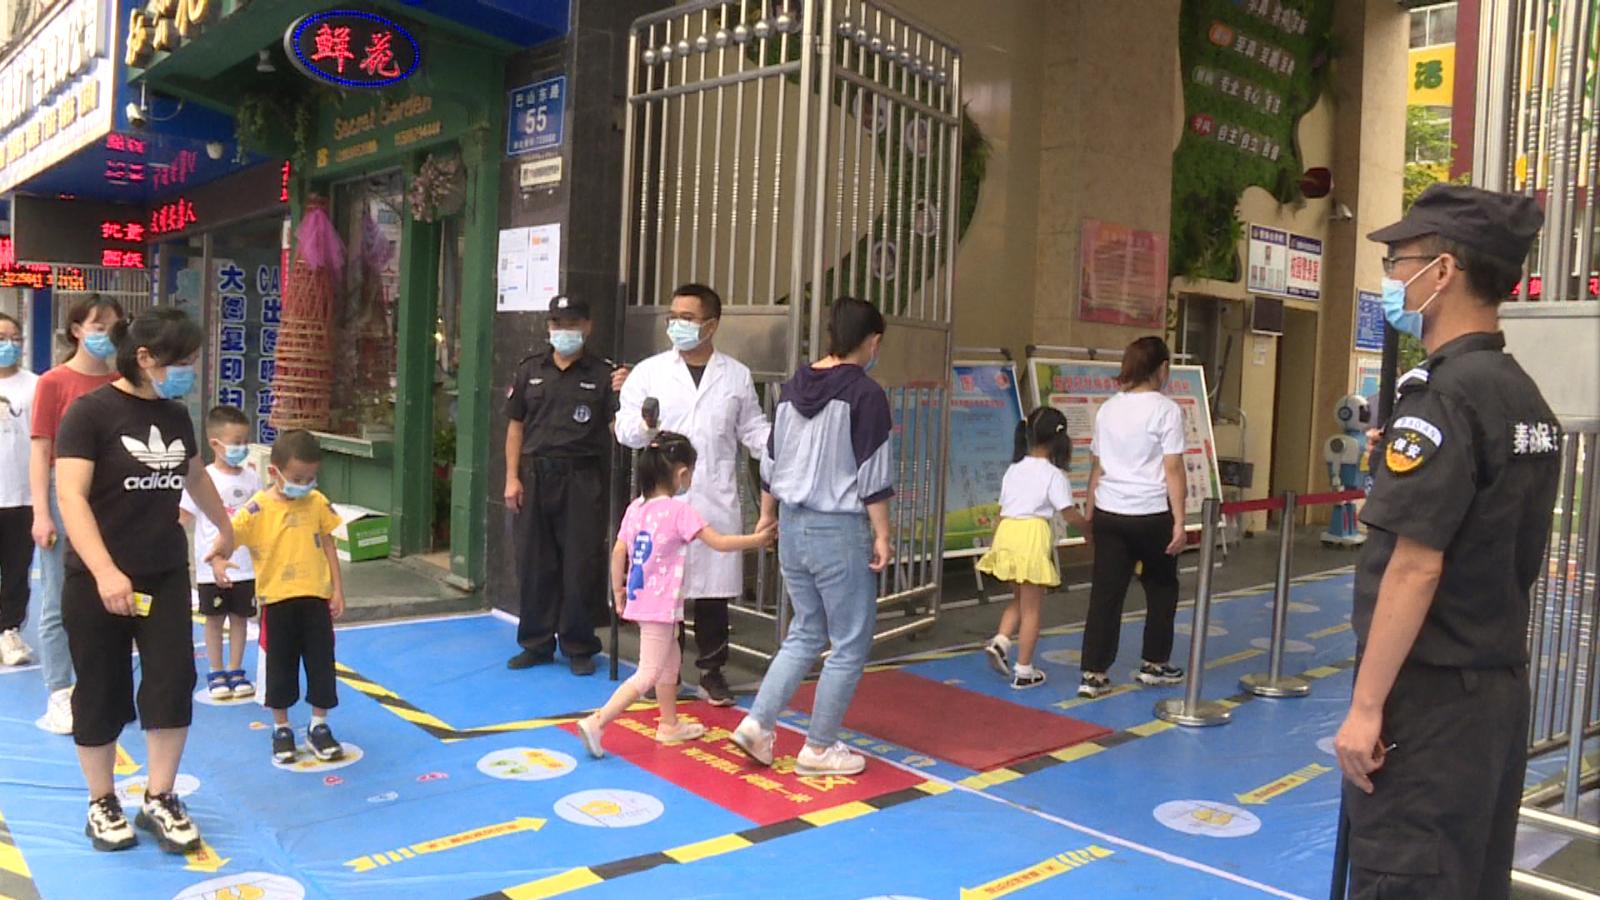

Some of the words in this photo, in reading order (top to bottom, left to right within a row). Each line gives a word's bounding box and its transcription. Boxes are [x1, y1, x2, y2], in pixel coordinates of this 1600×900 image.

[311, 23, 401, 77] 鲜花
[515, 83, 560, 108] 巴山东路
[335, 107, 377, 141] Secret
[380, 94, 433, 126] Garden
[525, 105, 548, 134] 55
[258, 266, 280, 293] CA
[124, 471, 184, 490] adida
